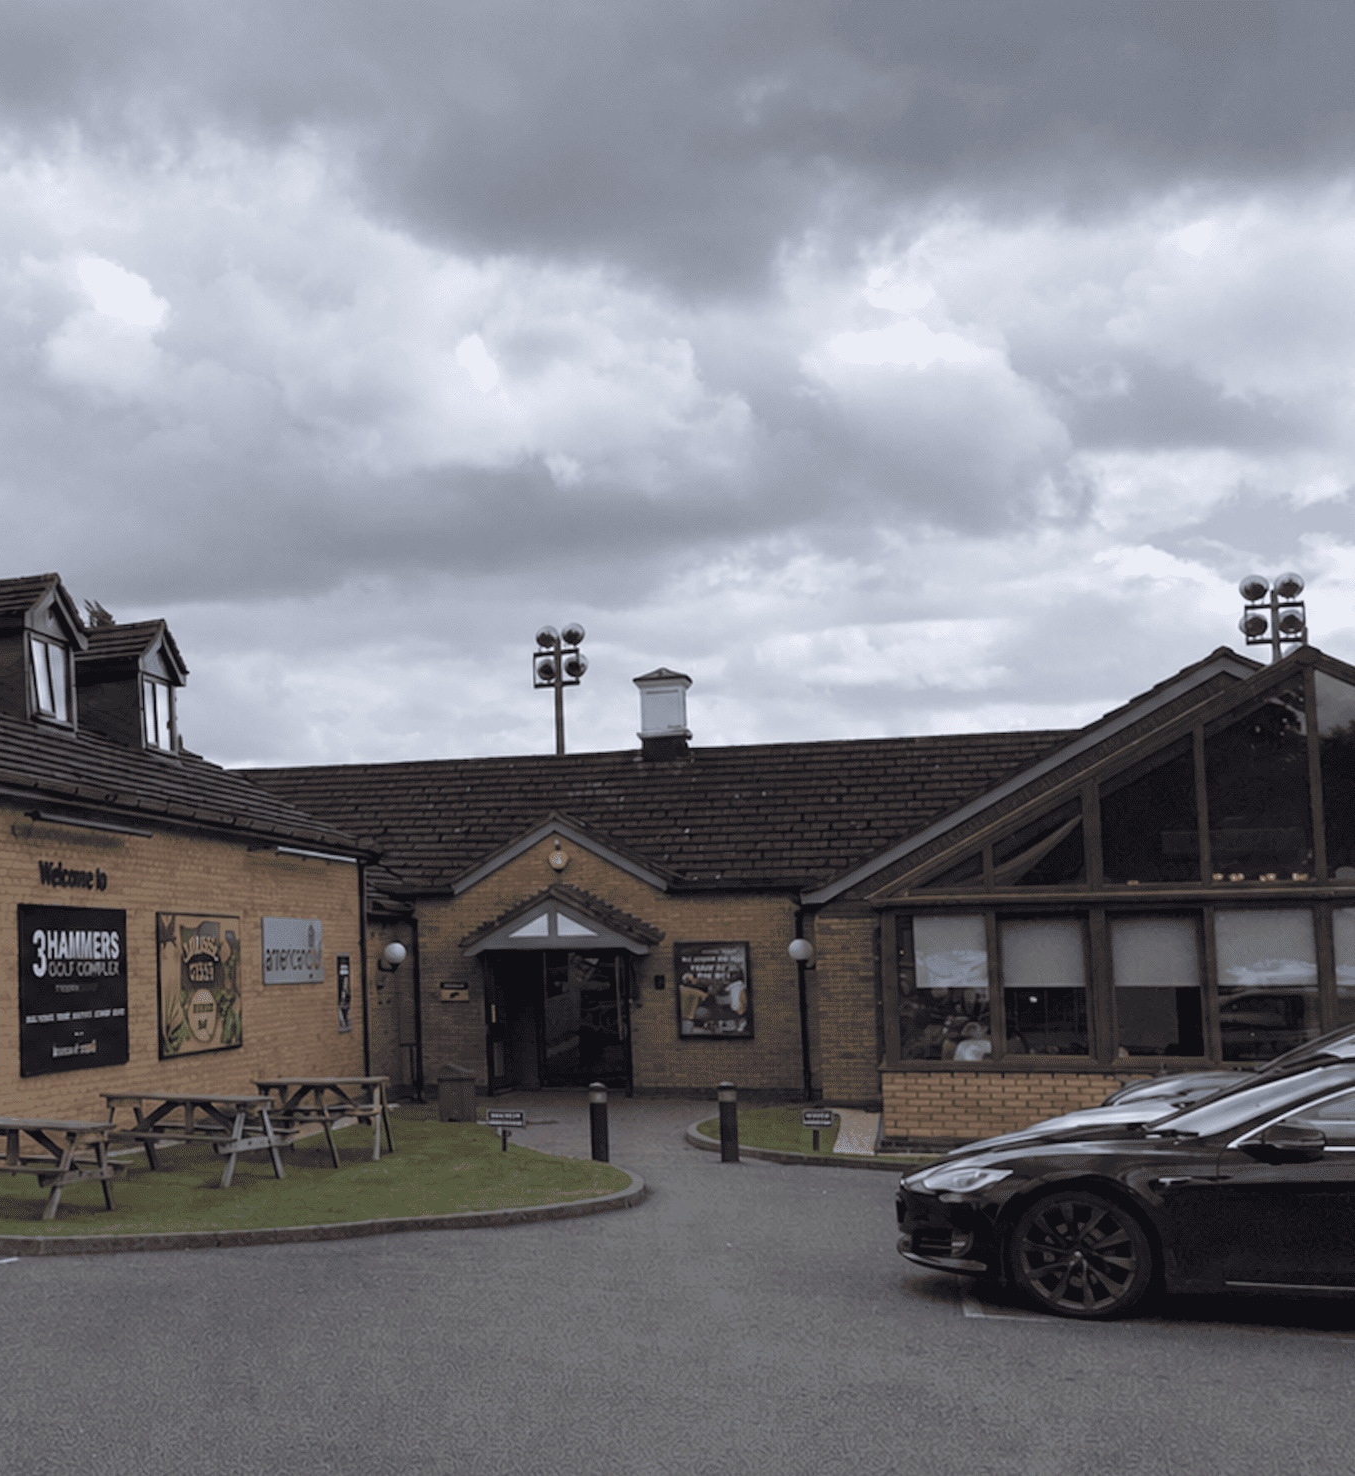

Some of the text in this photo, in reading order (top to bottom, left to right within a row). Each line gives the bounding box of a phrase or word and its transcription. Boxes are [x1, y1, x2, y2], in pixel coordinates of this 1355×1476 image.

[38, 860, 93, 891] Welcome
[32, 929, 120, 978] 3 HAMMERS
[48, 961, 74, 977] GOLF
